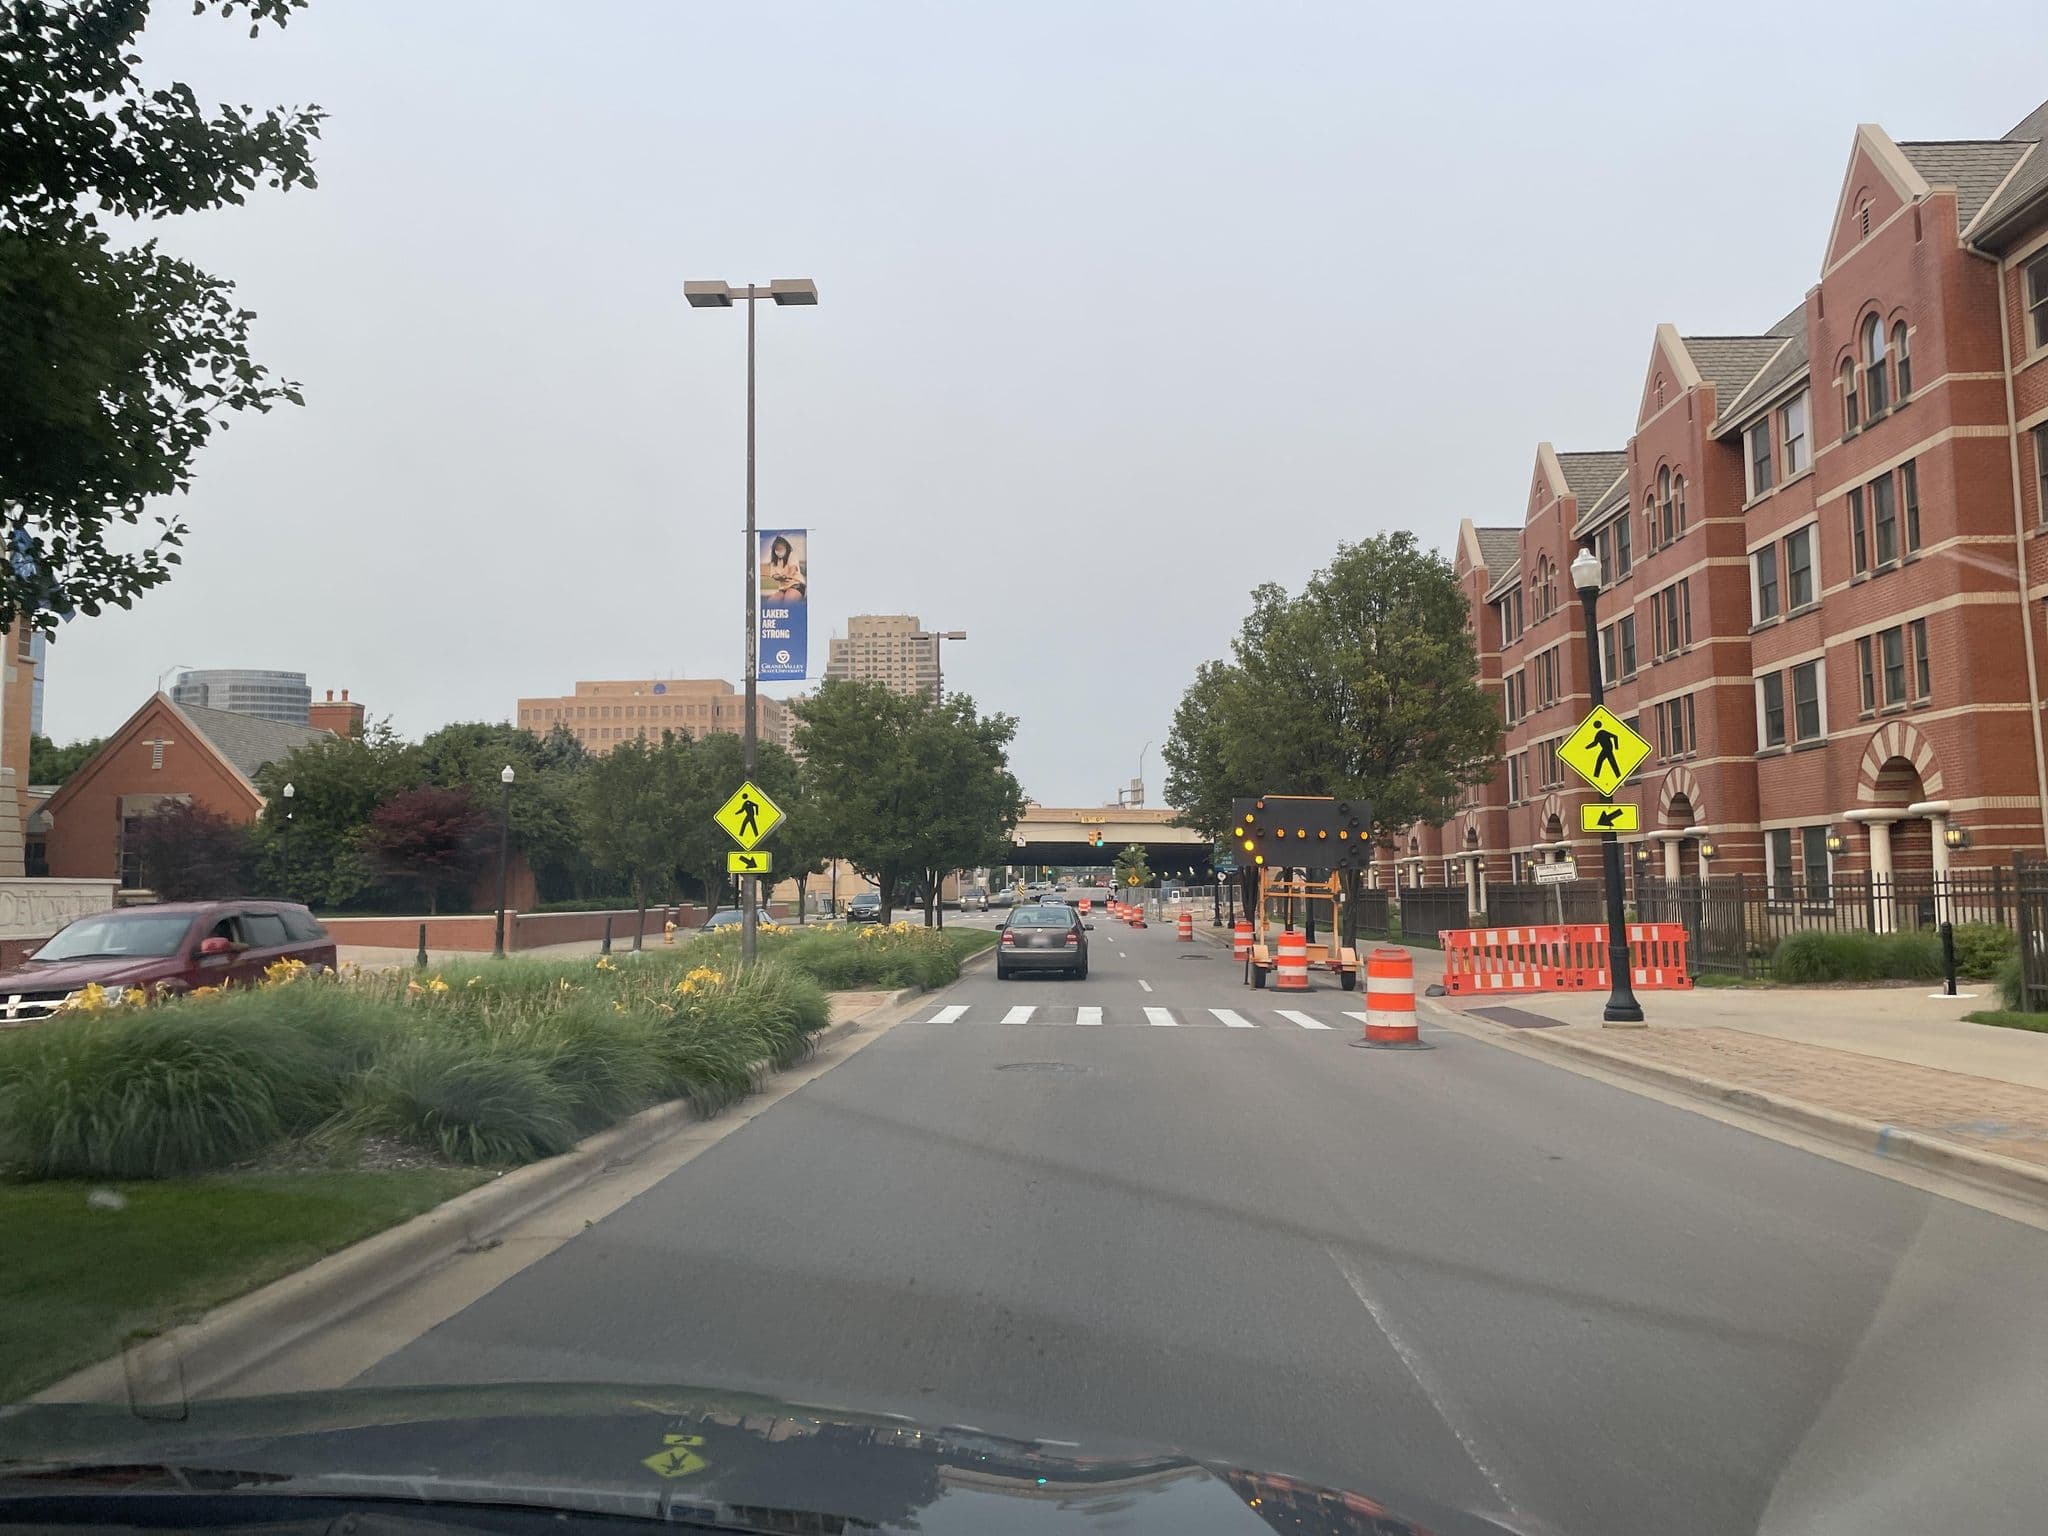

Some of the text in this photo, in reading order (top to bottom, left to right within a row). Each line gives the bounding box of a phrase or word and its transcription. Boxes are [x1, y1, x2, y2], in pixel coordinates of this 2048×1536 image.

[762, 609, 789, 618] LAKERS
[762, 619, 776, 628] ARE
[762, 629, 790, 639] STRONG
